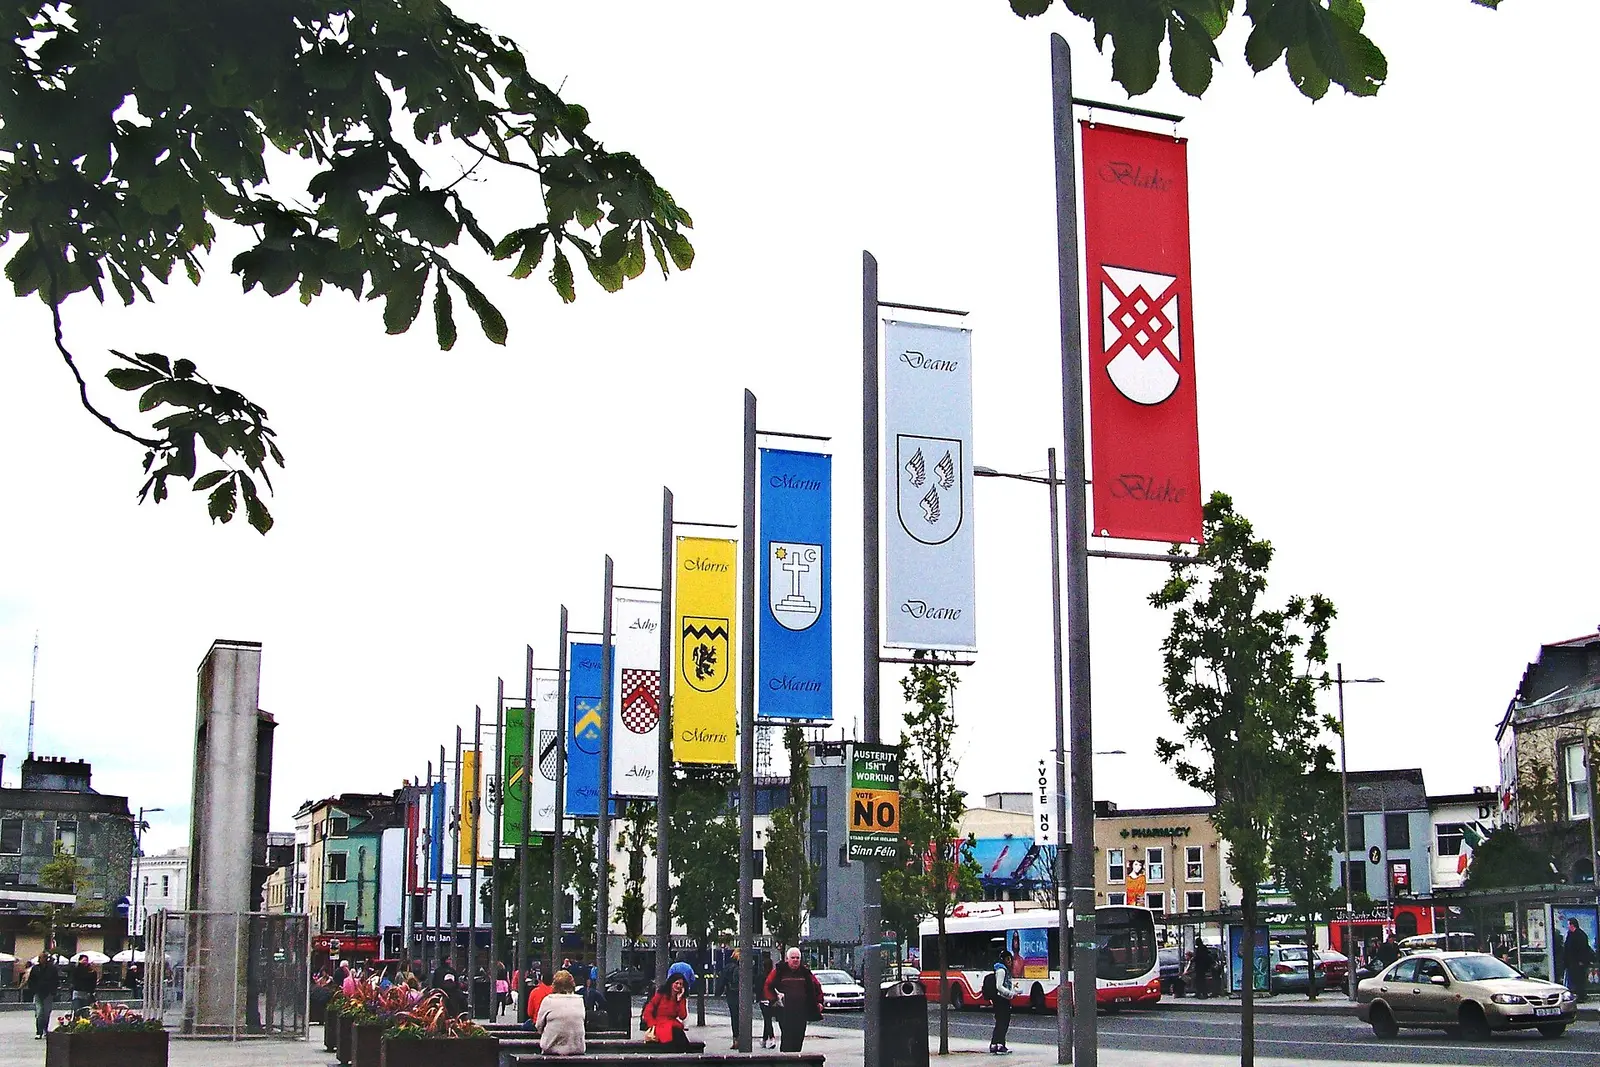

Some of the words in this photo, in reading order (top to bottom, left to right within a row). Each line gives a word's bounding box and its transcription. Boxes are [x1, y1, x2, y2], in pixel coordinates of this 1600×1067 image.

[1098, 161, 1174, 192] Blake
[899, 350, 958, 372] Deane
[769, 473, 821, 490] Martin
[1109, 473, 1187, 503] Blake
[683, 556, 729, 573] Morris
[900, 599, 961, 620] Deane
[628, 617, 658, 633] Athy
[768, 674, 822, 691] Martin
[681, 727, 728, 743] Morris
[853, 750, 898, 763] AUSTERITY
[624, 764, 655, 780] Athy
[865, 762, 887, 771] ISN'T
[856, 772, 895, 783] WORKING
[1038, 767, 1048, 805] VOTE
[856, 791, 873, 799] VOTE
[853, 800, 895, 828] NO
[1040, 813, 1050, 832] NO
[1131, 826, 1191, 838] PHARMACY
[850, 844, 873, 856] Sinn
[873, 845, 896, 857] Féin
[70, 922, 101, 930] Express
